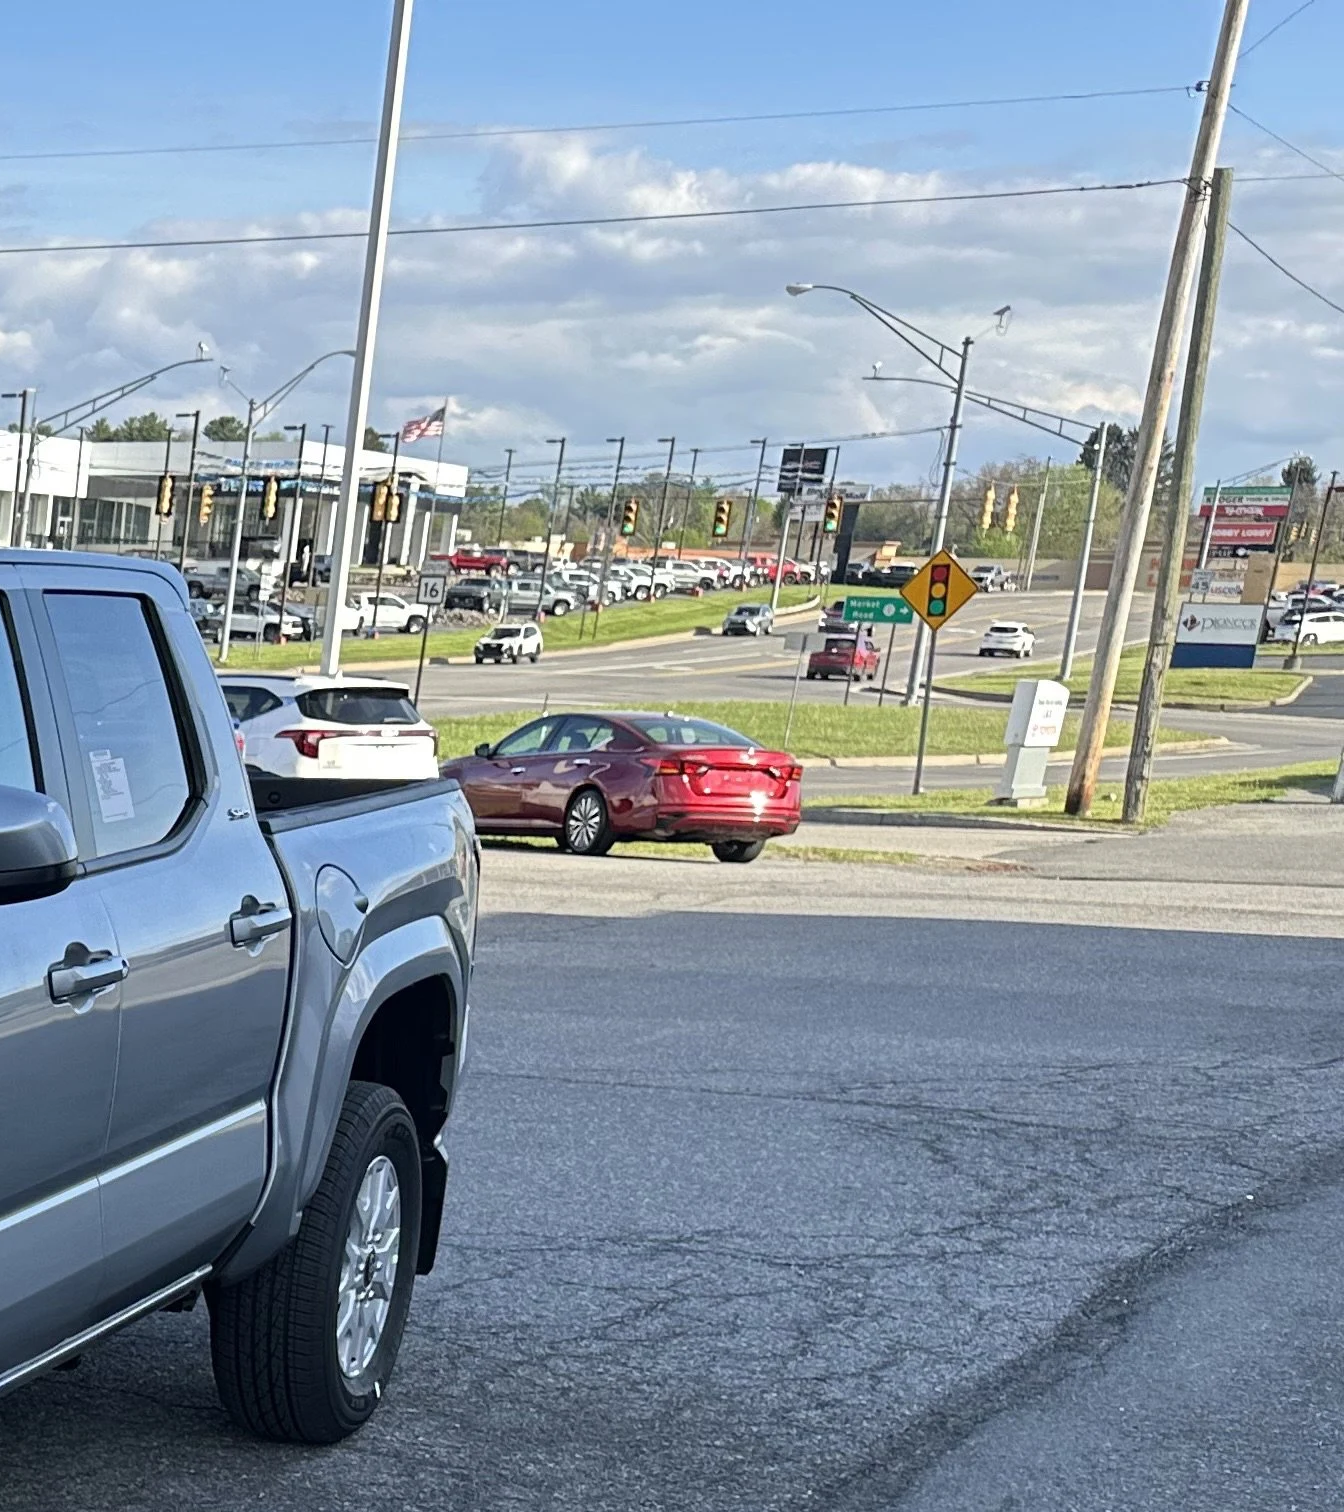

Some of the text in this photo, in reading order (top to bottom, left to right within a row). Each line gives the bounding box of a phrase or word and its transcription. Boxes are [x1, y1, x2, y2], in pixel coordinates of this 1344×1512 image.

[424, 583, 438, 598] 16
[850, 600, 880, 609] Market
[852, 611, 874, 620] Road
